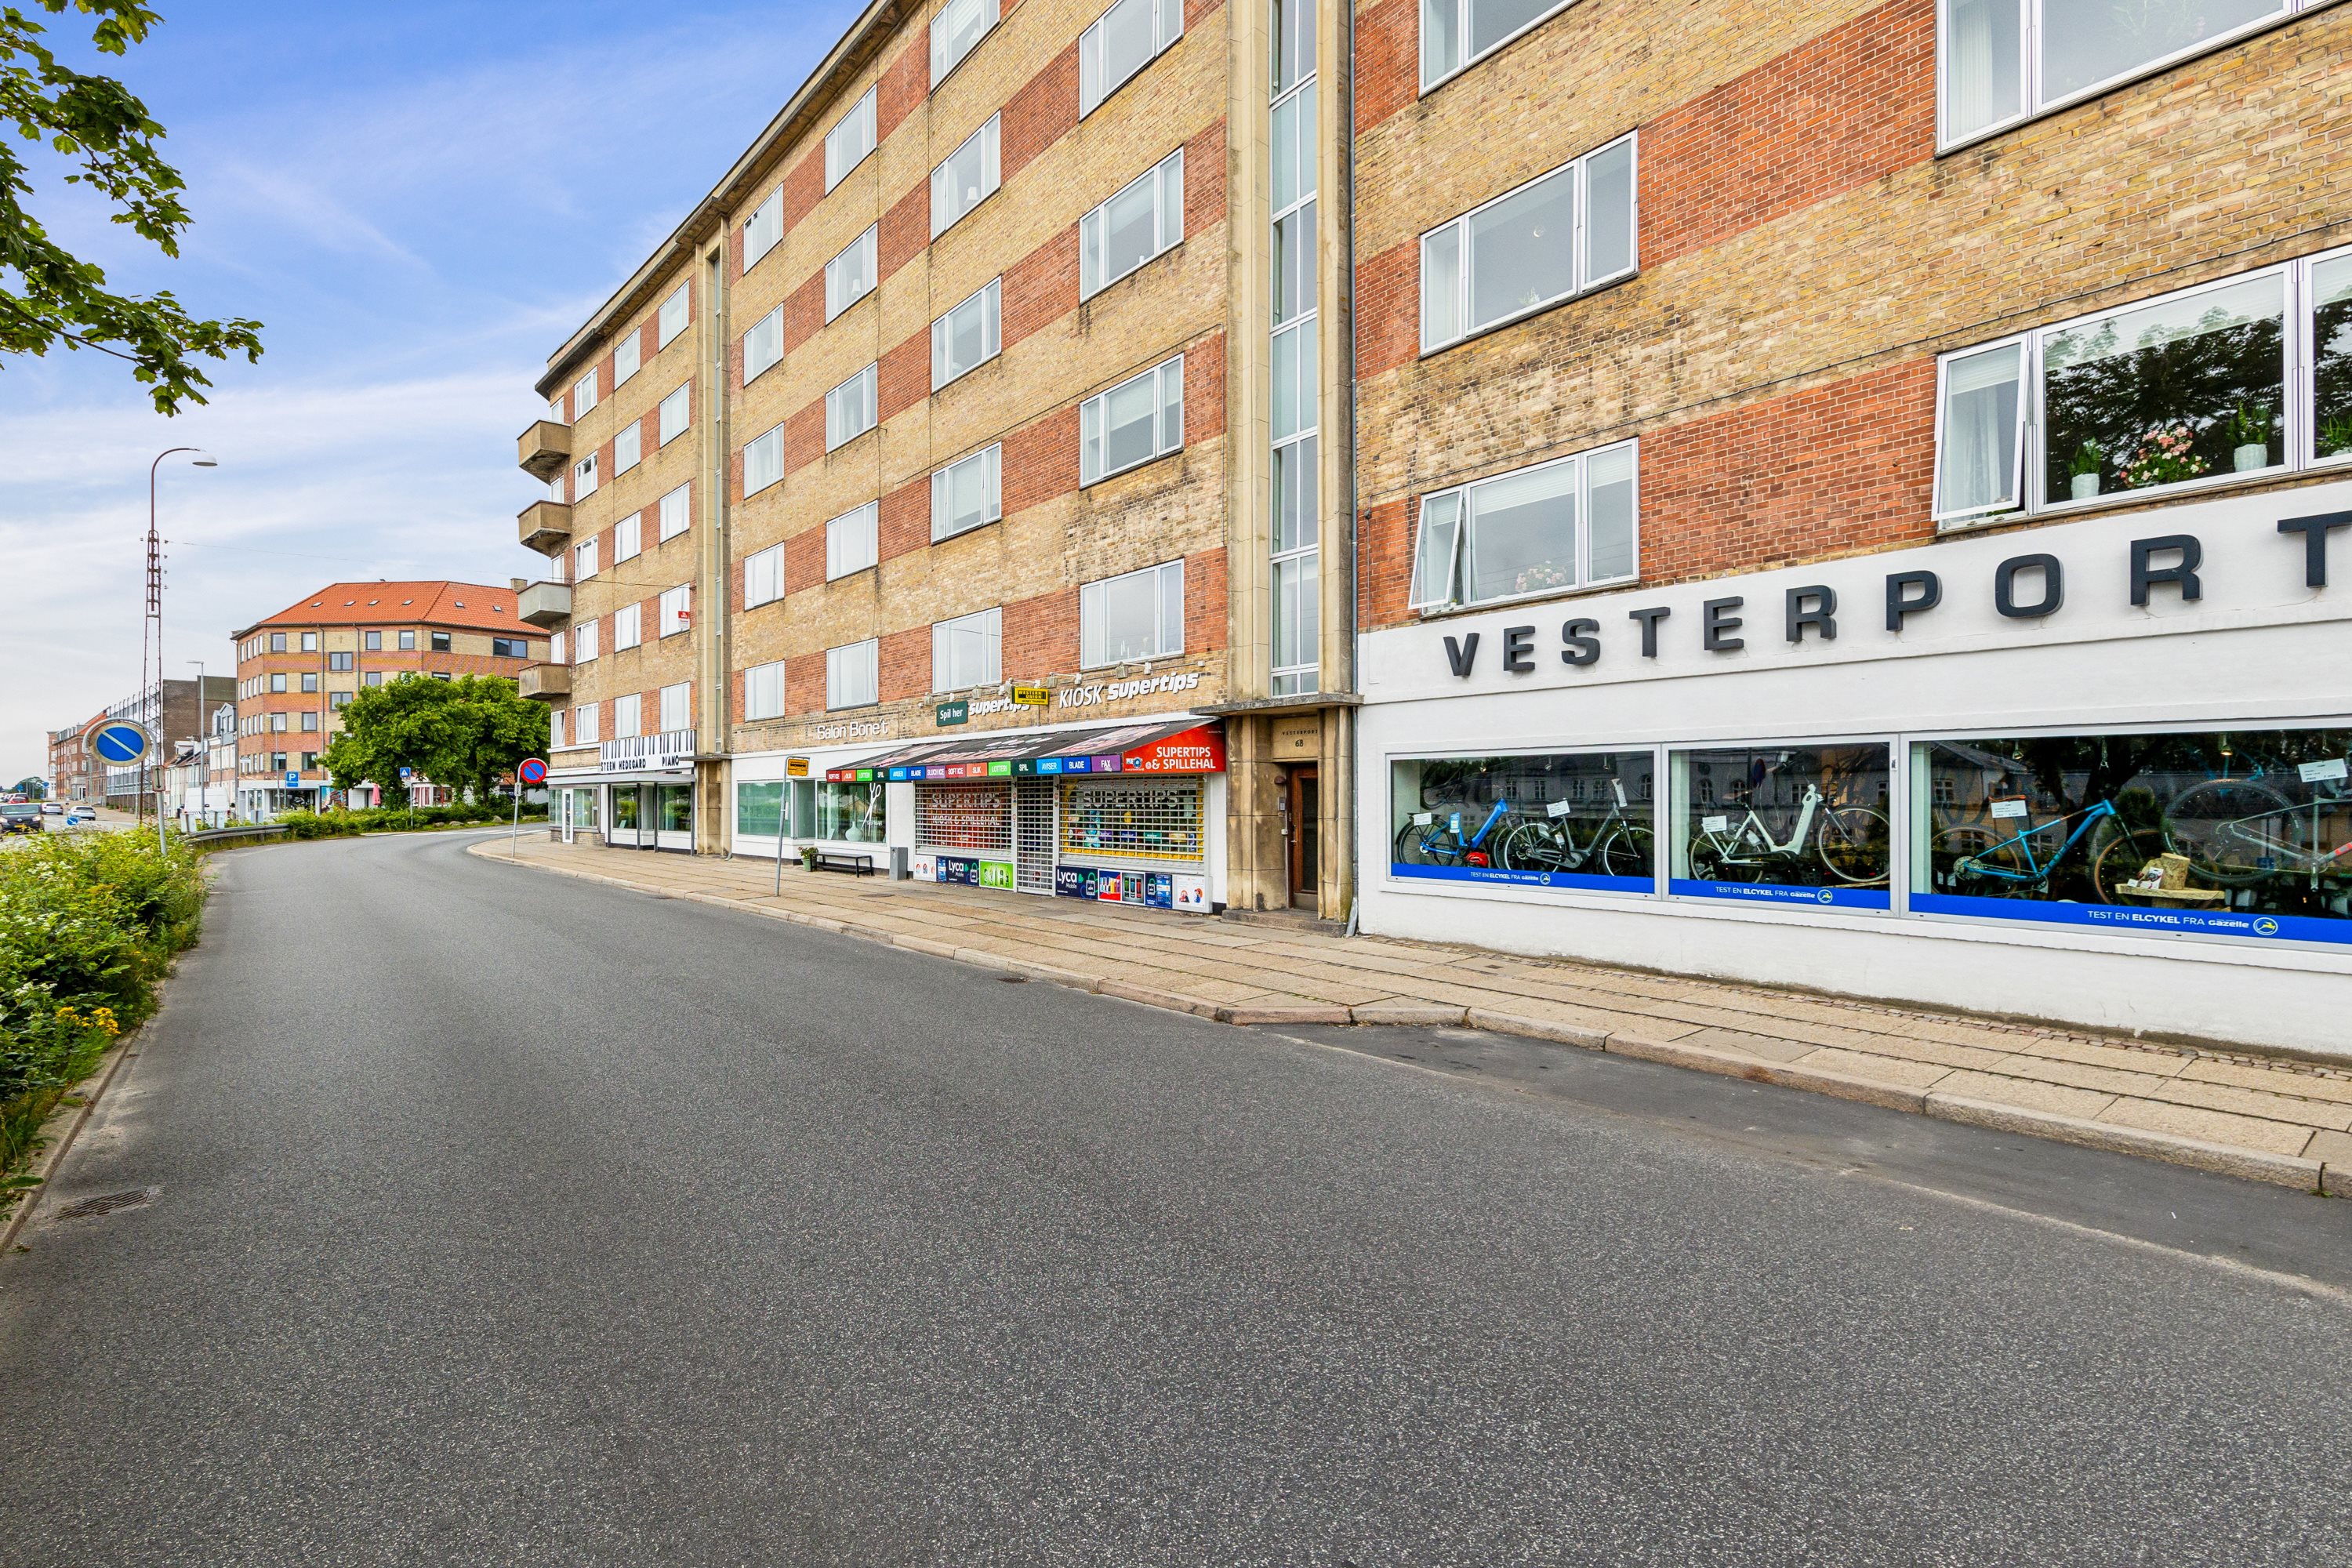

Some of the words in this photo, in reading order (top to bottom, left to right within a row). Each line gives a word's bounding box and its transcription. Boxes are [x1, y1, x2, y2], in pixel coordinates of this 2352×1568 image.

[1443, 510, 2352, 677] VESTERPORT
[1059, 684, 1103, 708] KIOSK
[1107, 672, 1200, 700] supertips
[940, 709, 951, 720] Spil
[953, 708, 963, 717] her
[817, 725, 847, 740] Salon
[1156, 746, 1210, 757] SUPERTIPS
[601, 761, 615, 771] STEEN
[662, 754, 679, 767] PIANO
[1163, 759, 1216, 769] SPILLEHAL
[932, 793, 1000, 808] SUPERTIPS
[1083, 790, 1178, 808] SUPERTIPS
[949, 860, 964, 873] Lyca
[1057, 869, 1077, 884] Lyca
[2132, 913, 2180, 924] ELCYKEL
[2183, 916, 2205, 925] FRA
